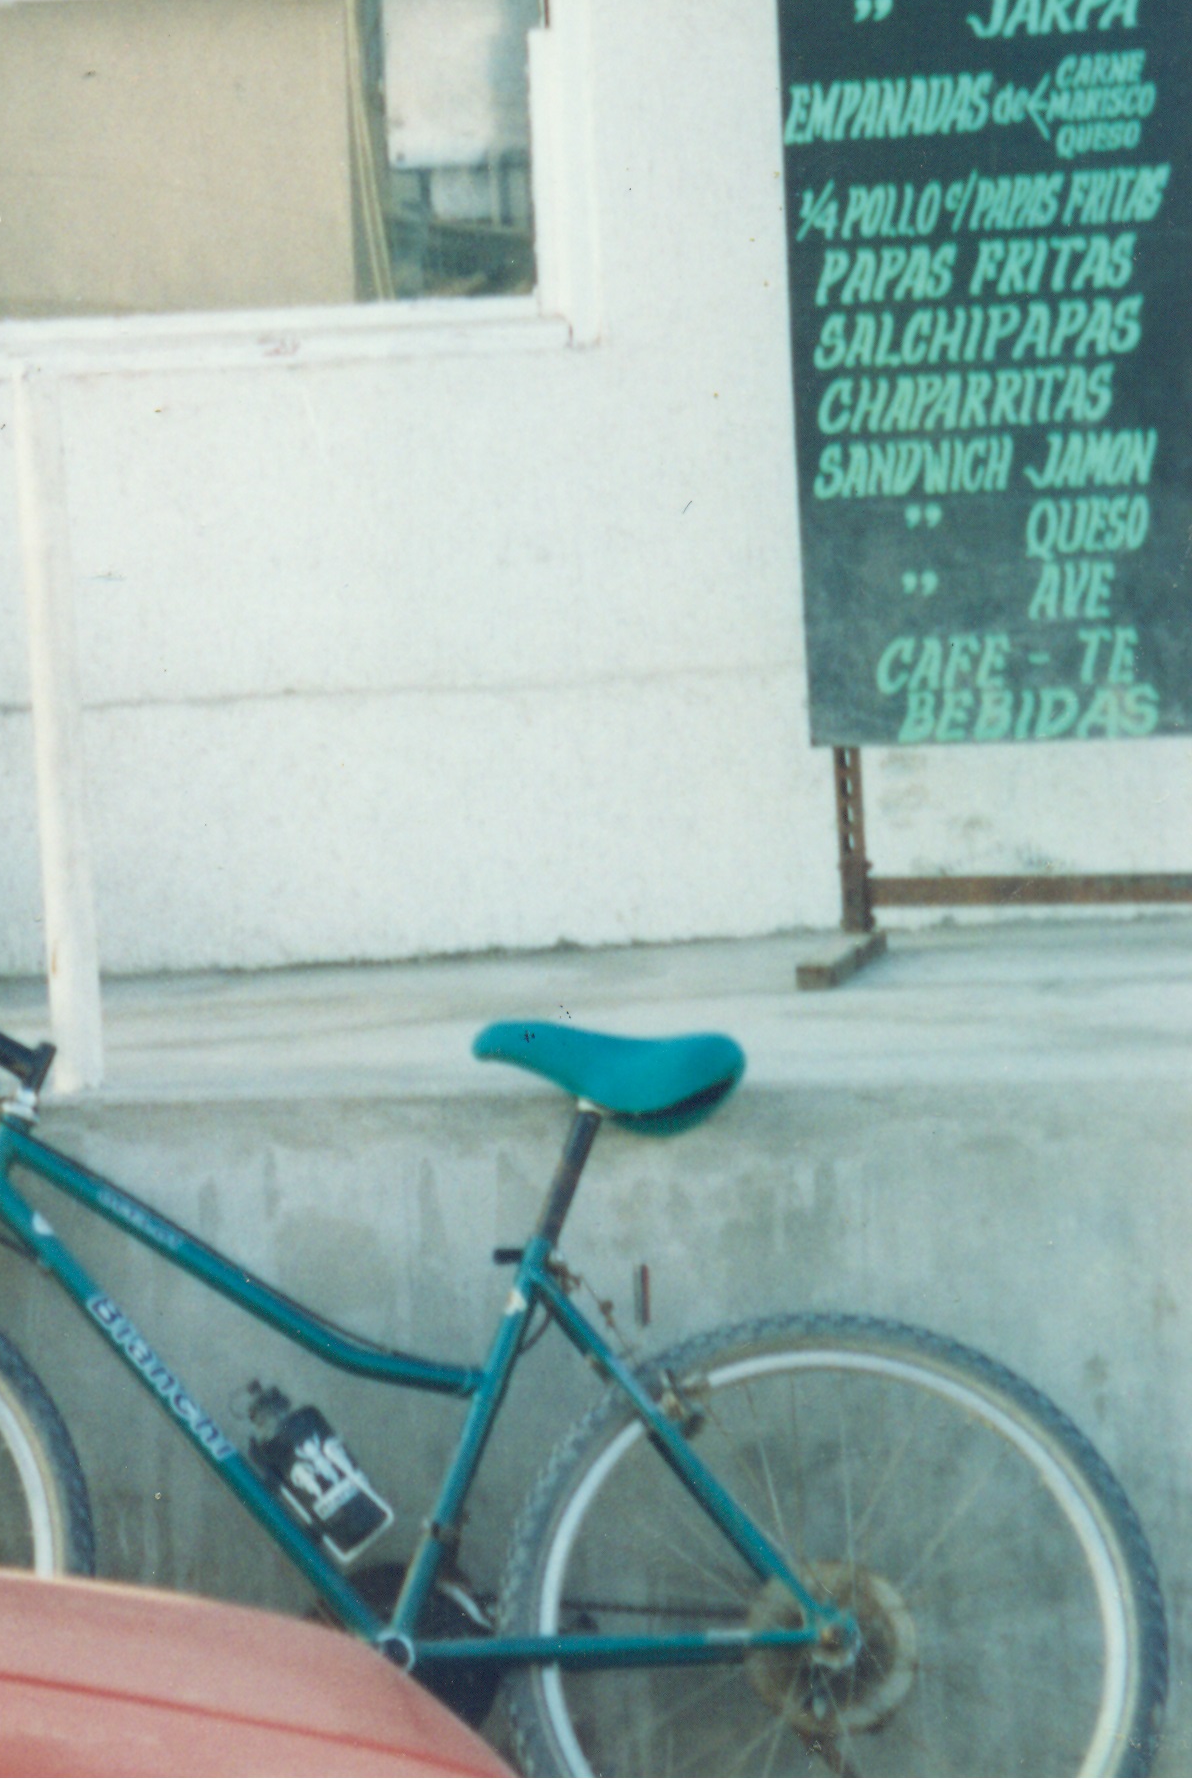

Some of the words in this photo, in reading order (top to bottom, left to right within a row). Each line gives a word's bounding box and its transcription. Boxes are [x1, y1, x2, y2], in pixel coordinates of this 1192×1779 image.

[1047, 82, 1156, 121] MARISCO
[1055, 49, 1147, 89] CARNE
[785, 72, 993, 145] EMPANADAS
[1056, 120, 1141, 158] QUESO
[841, 182, 942, 239] POLLO
[1064, 163, 1170, 224] FRITAS
[816, 242, 957, 306] PAPAS
[970, 232, 1136, 295] FRITAS
[814, 294, 1143, 370] SALCHIPAPAS
[818, 363, 1115, 434] CHAPARRITAS
[814, 435, 1012, 499] SANDWICH
[1024, 428, 1158, 489] JAMON
[1026, 494, 1150, 561] QUESO
[1029, 561, 1114, 620] AVE
[876, 633, 1010, 694] CAFE
[1078, 626, 1139, 683] TE
[898, 683, 1160, 742] BEBIDAS
